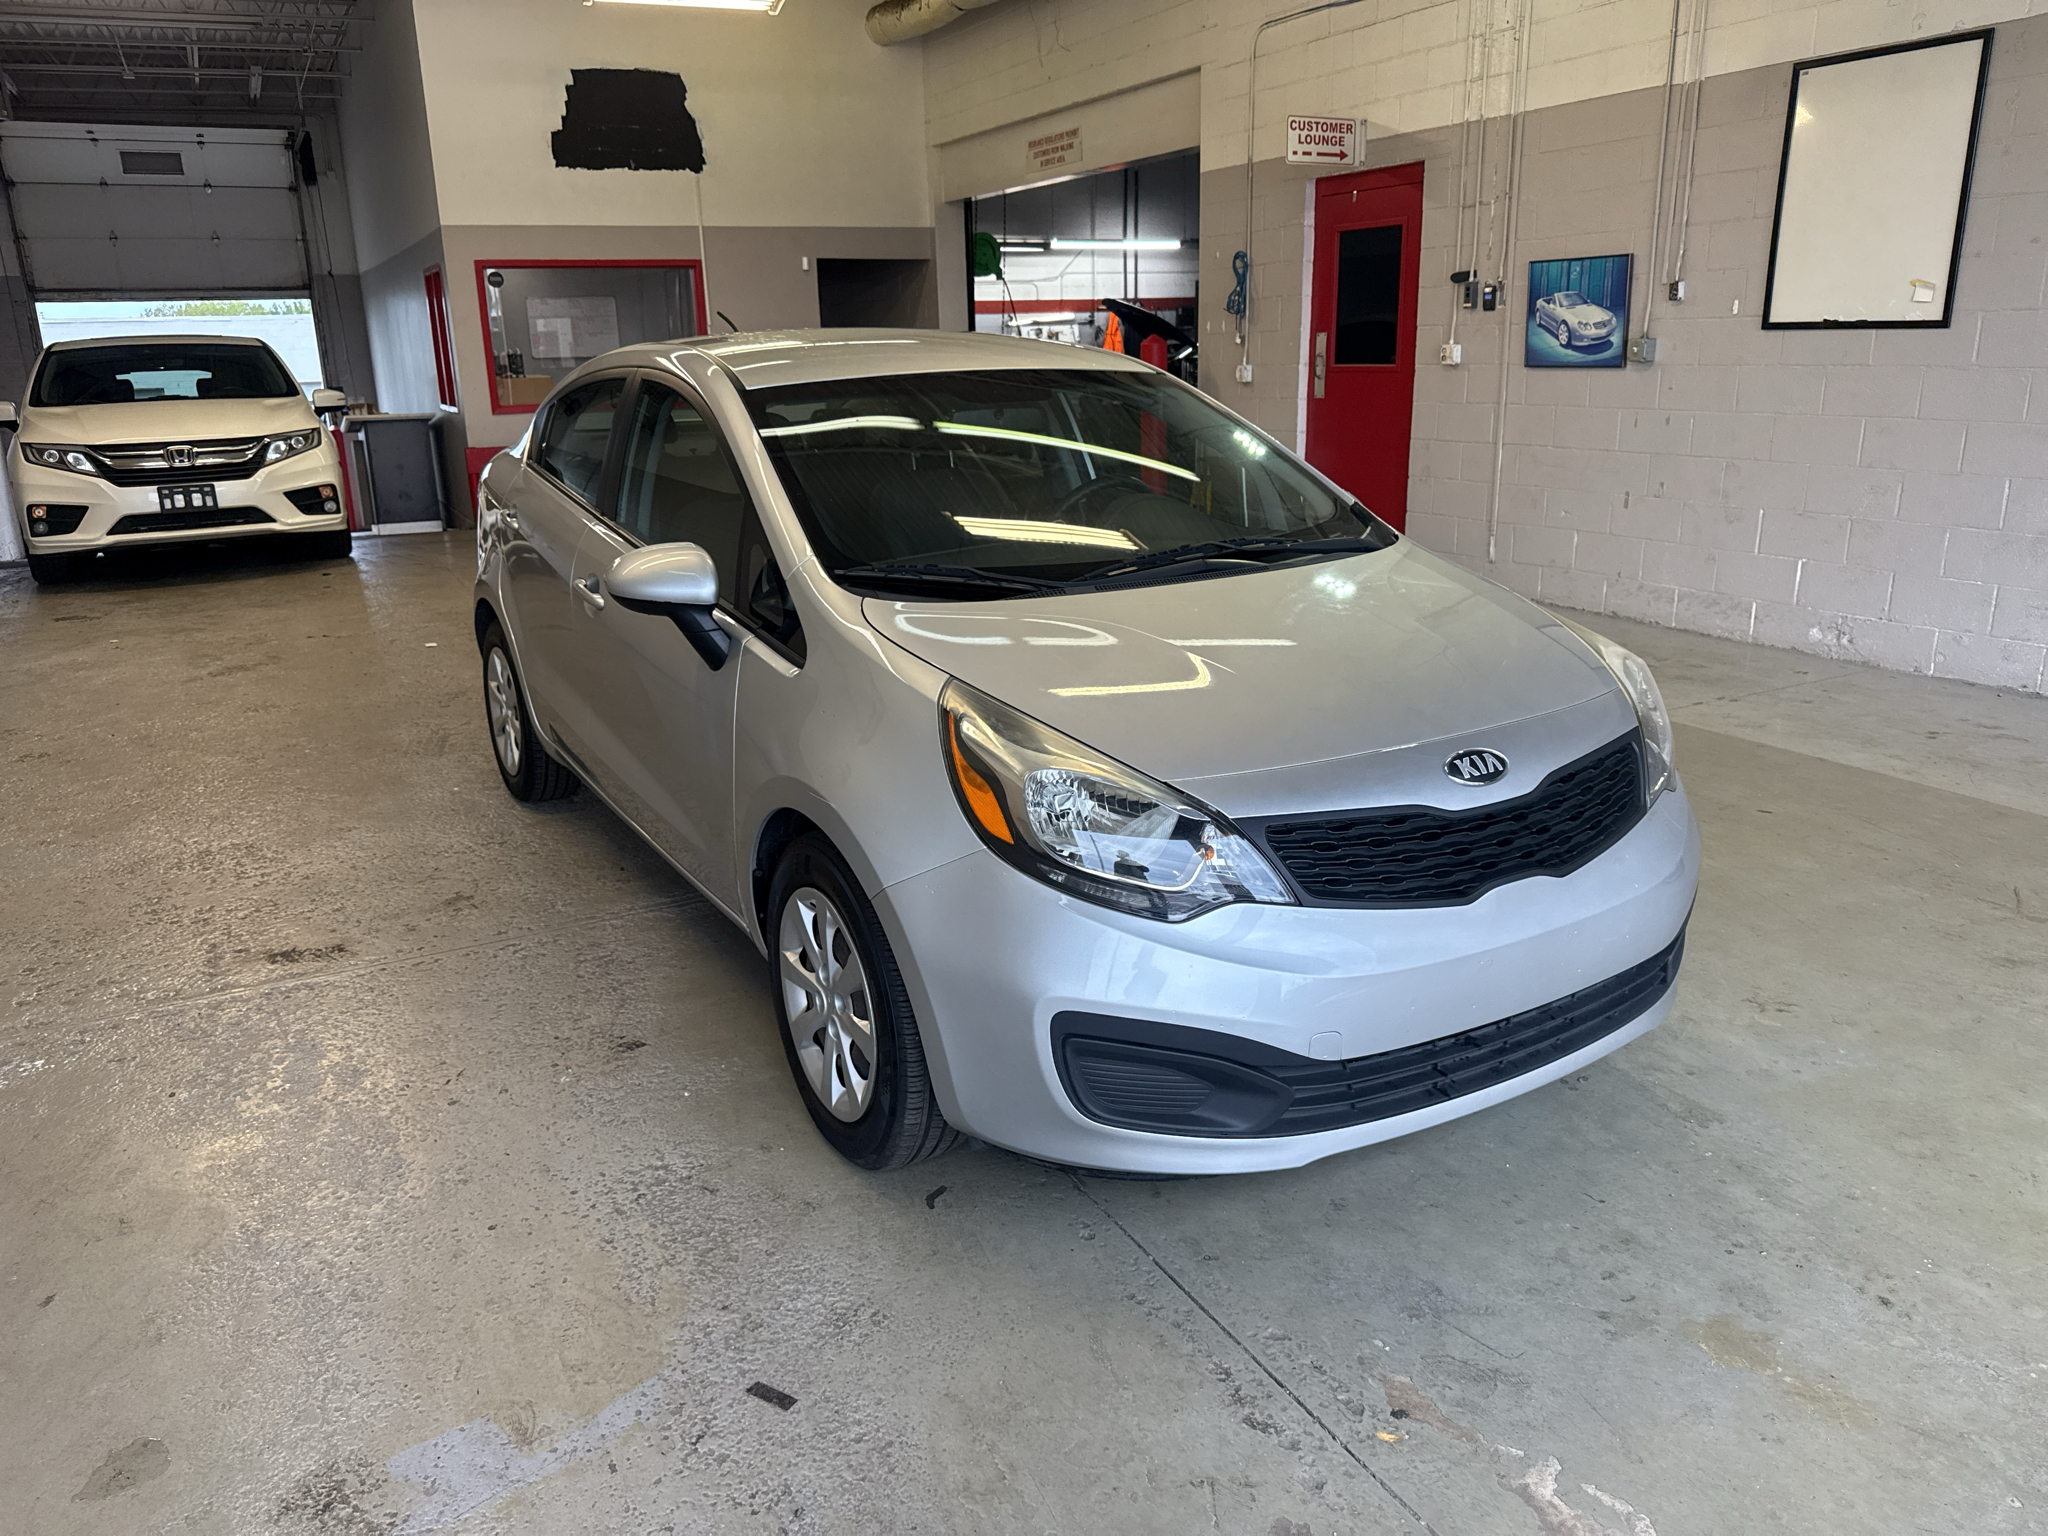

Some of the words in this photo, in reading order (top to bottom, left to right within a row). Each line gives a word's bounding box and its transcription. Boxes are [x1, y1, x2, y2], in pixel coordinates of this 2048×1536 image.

[1290, 120, 1353, 134] CUSTOMER
[1298, 133, 1345, 147] LOUNGE
[1453, 752, 1503, 779] KIA
